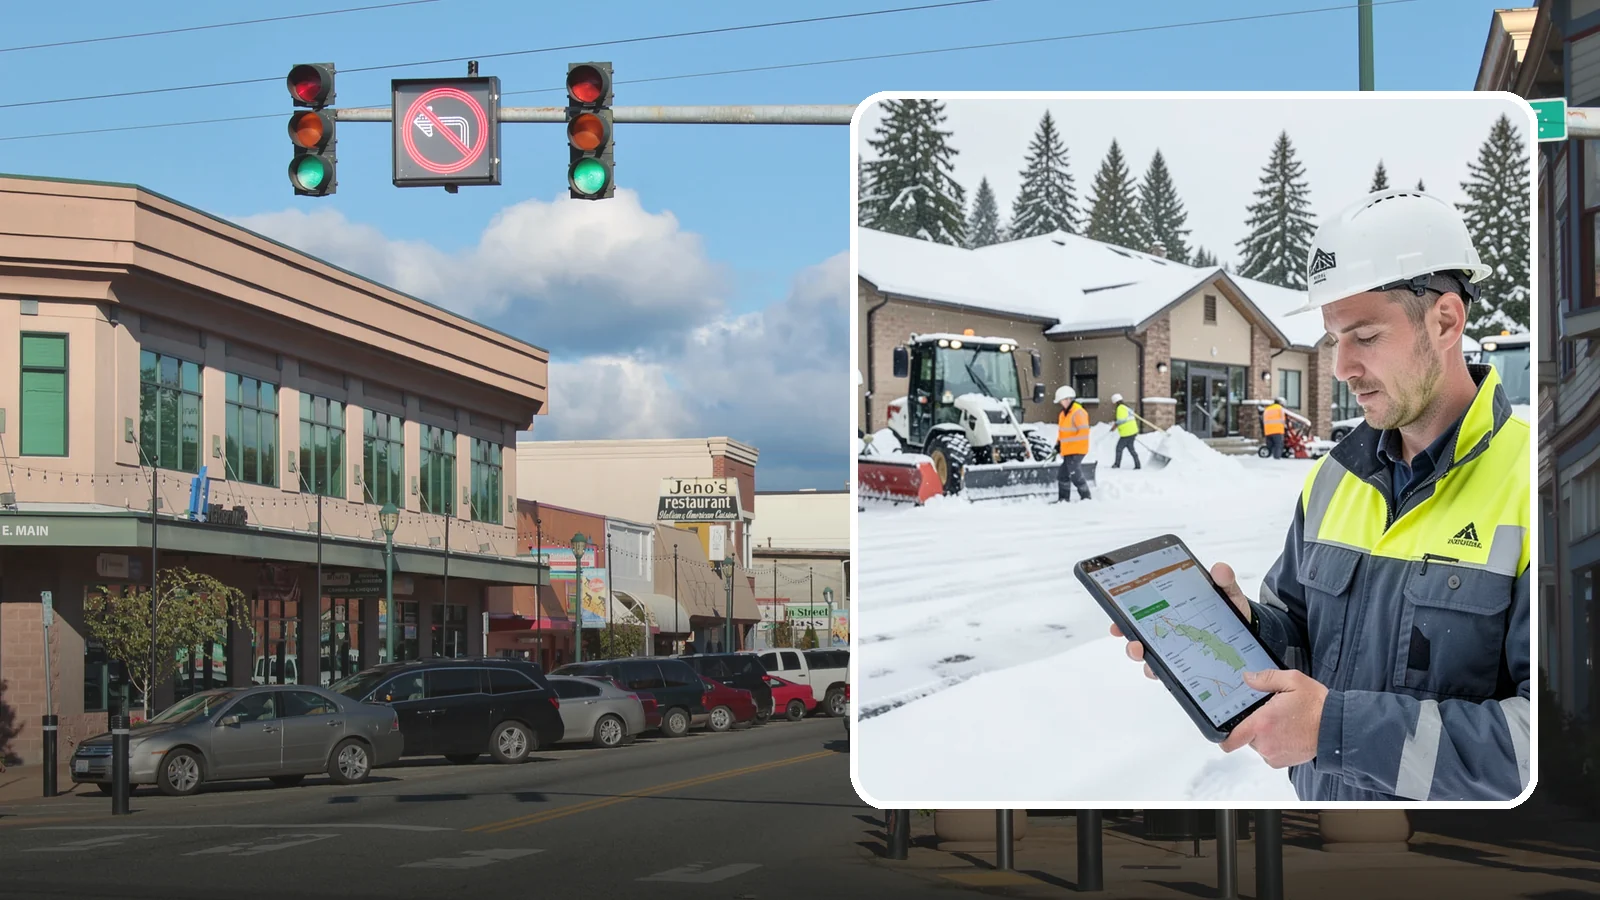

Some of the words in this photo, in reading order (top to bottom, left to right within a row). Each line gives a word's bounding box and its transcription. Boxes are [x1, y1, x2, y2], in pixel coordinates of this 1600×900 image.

[669, 479, 728, 495] Jeno's
[665, 496, 731, 509] restaurant
[658, 510, 681, 519] Italian
[686, 509, 714, 519] American
[715, 509, 738, 519] Cuisine
[2, 525, 13, 536] E.
[15, 525, 49, 537] MAIN
[785, 607, 795, 617] in
[797, 607, 828, 617] Street
[790, 619, 824, 627] lass
